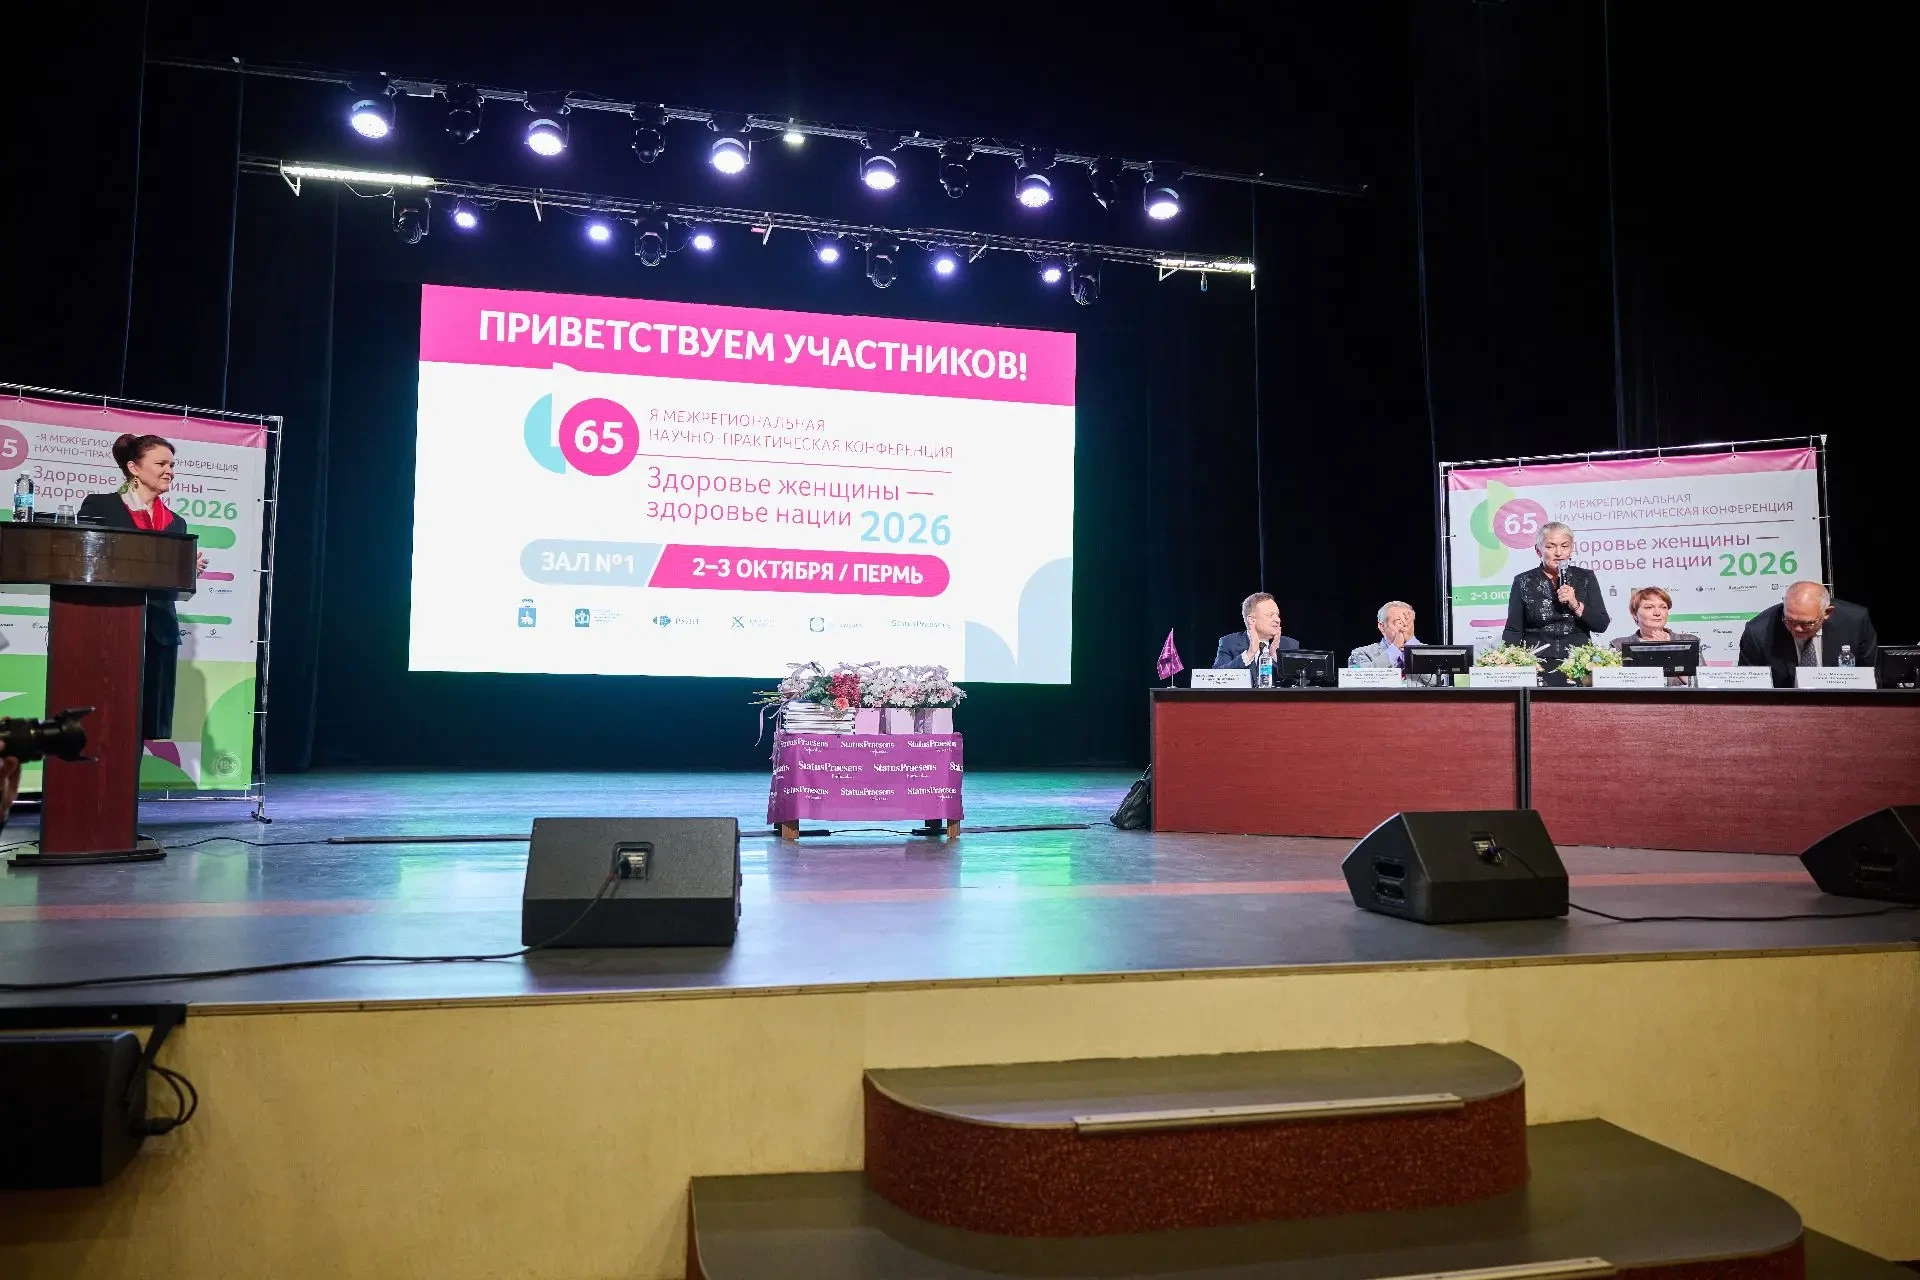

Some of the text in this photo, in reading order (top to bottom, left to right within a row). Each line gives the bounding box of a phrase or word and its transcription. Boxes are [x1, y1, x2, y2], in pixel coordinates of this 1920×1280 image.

[479, 309, 1027, 381] ПРИВЕТСТВУЕМ УЧАСТНИКОВ!
[650, 408, 825, 432] Я МЕЖРЕГИОНАЛЬНАЯ
[1, 438, 18, 458] 5
[49, 434, 115, 448] МЕЖРЕГИОН
[574, 419, 624, 455] 65
[649, 428, 953, 459] НАУЧНО-ПРАКТИЧЕСКАЯ КОНФЕРЕНЦИЯ
[34, 444, 238, 472] НАУЧНО-ПРАК ОНФЕРЕНЦИЯ
[33, 465, 117, 486] Здоровье
[647, 466, 771, 497] Здоровье
[777, 478, 899, 502] женщины
[176, 497, 238, 520] 2026
[1554, 501, 1793, 522] НАУЧНО-ПРАКТИЧЕСКАЯ КОНФЕРЕНЦИЯ
[1569, 493, 1691, 509] МЕЖРЕГИОНАЛЬНАЯ
[646, 501, 951, 546] здоровье нации 2026
[1504, 512, 1538, 535] 65
[1571, 538, 1647, 556] доровье
[1652, 534, 1750, 549] женщины
[541, 551, 634, 574] ЗАЛ №1
[736, 558, 834, 581] ОКТЯБРЯ
[853, 563, 924, 584] ПЕРМЬ
[1652, 555, 1712, 570] нации
[1719, 550, 1798, 577] 2026
[798, 760, 863, 772] StatusPraesens
[873, 763, 937, 772] StatusPraesens
